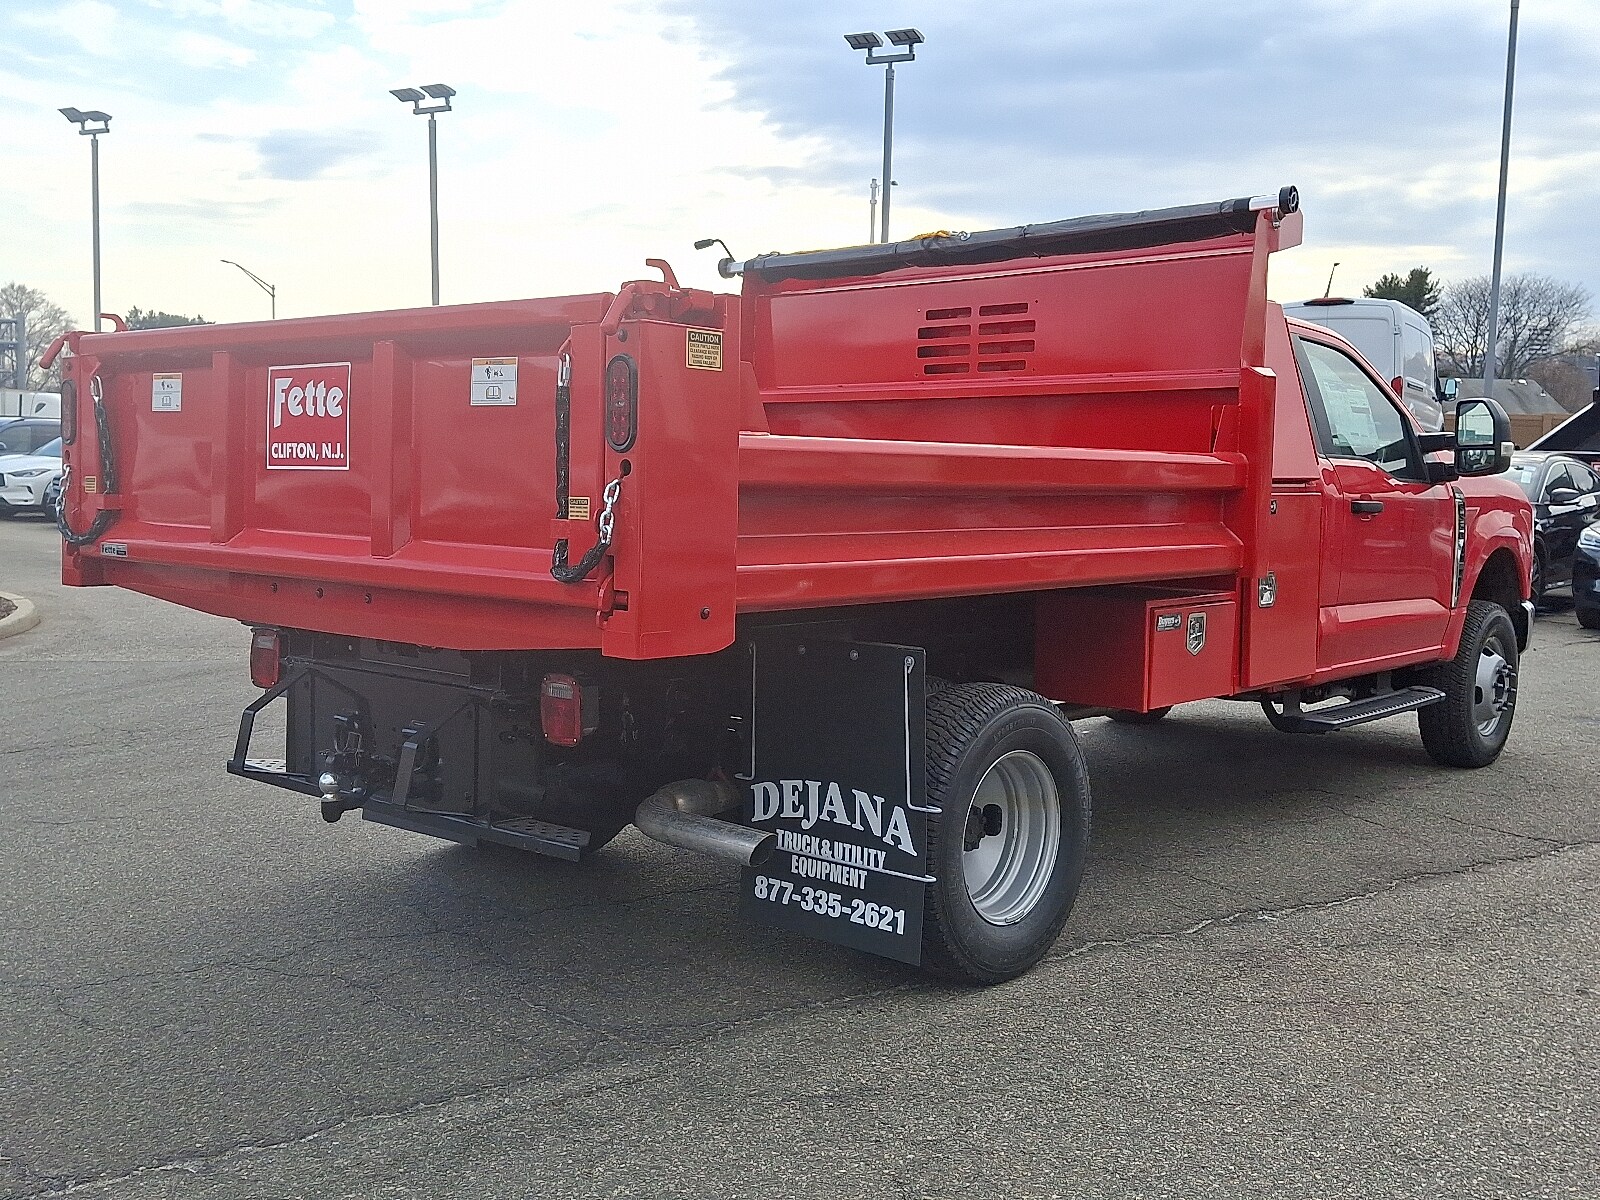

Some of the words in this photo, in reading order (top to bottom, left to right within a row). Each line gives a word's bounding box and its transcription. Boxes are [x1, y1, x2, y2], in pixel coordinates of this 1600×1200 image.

[690, 332, 719, 343] CAUTION
[273, 377, 344, 428] Fette
[271, 442, 320, 461] CLIFTON,
[322, 442, 344, 459] N.J.
[750, 779, 918, 857] DEJANA
[791, 854, 868, 890] EQUIPMENT
[754, 875, 905, 935] 877-335-2621
